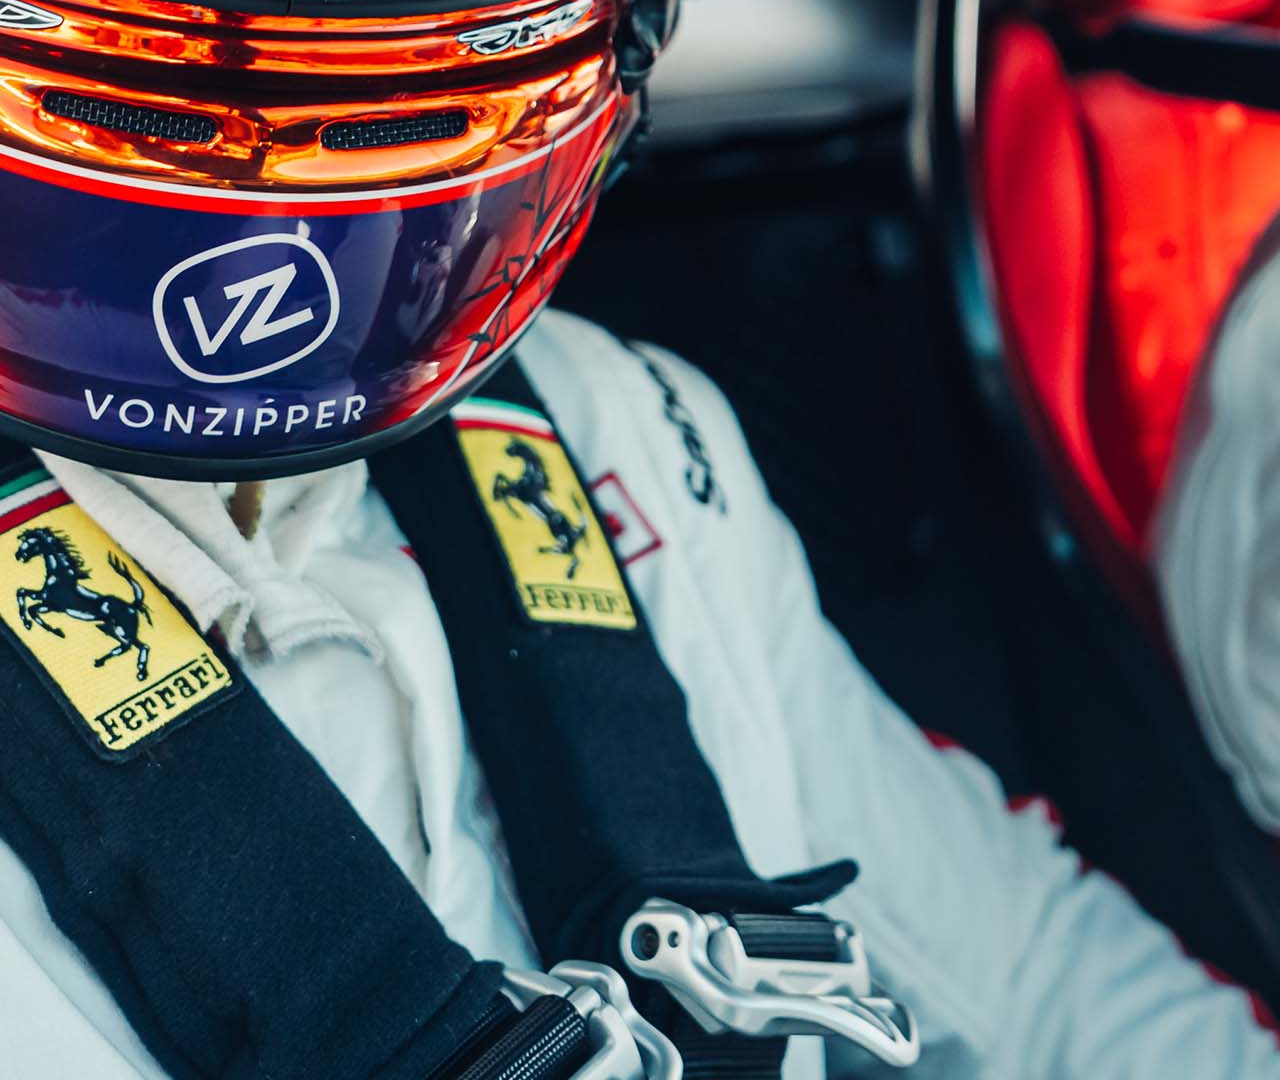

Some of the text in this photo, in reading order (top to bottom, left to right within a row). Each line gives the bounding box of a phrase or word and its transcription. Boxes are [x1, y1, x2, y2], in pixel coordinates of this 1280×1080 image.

[183, 262, 314, 357] VZ
[84, 388, 367, 437] VONZIPPER
[94, 653, 225, 745] Ferrari
